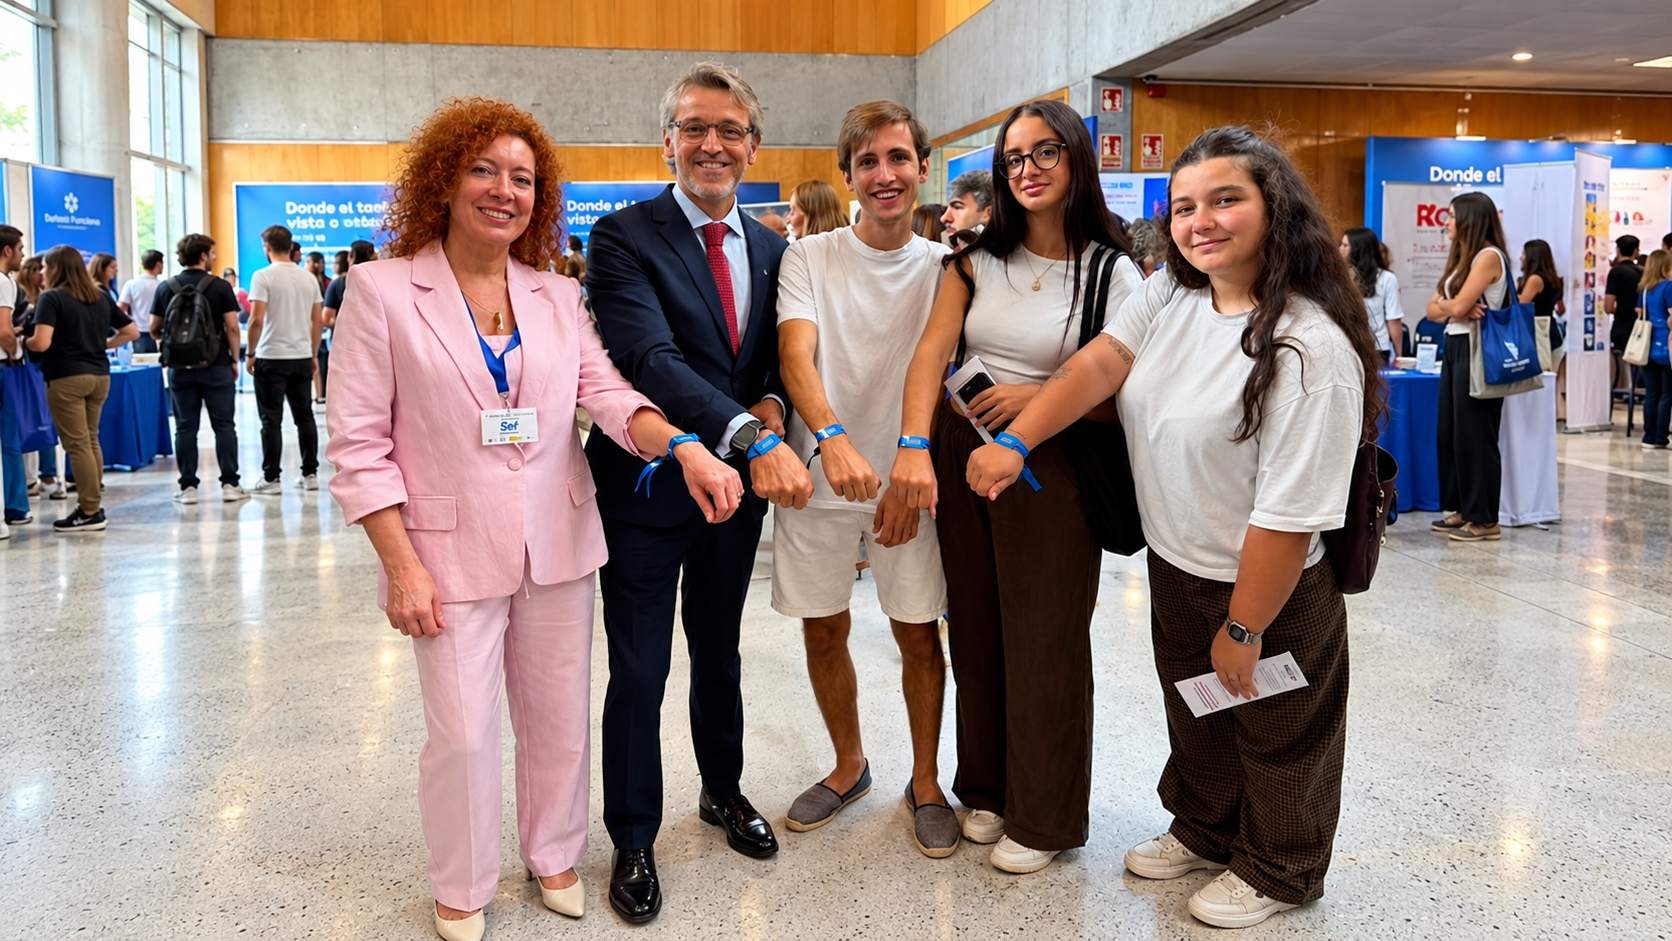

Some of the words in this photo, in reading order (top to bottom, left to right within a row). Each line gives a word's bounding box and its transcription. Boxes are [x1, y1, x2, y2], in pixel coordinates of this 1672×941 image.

[1430, 166, 1483, 182] Donde
[1486, 166, 1502, 182] el
[285, 201, 336, 215] Donde
[338, 201, 354, 214] el
[566, 199, 612, 212] Donde
[614, 199, 628, 210] el
[286, 216, 326, 229] vista
[329, 218, 340, 229] o
